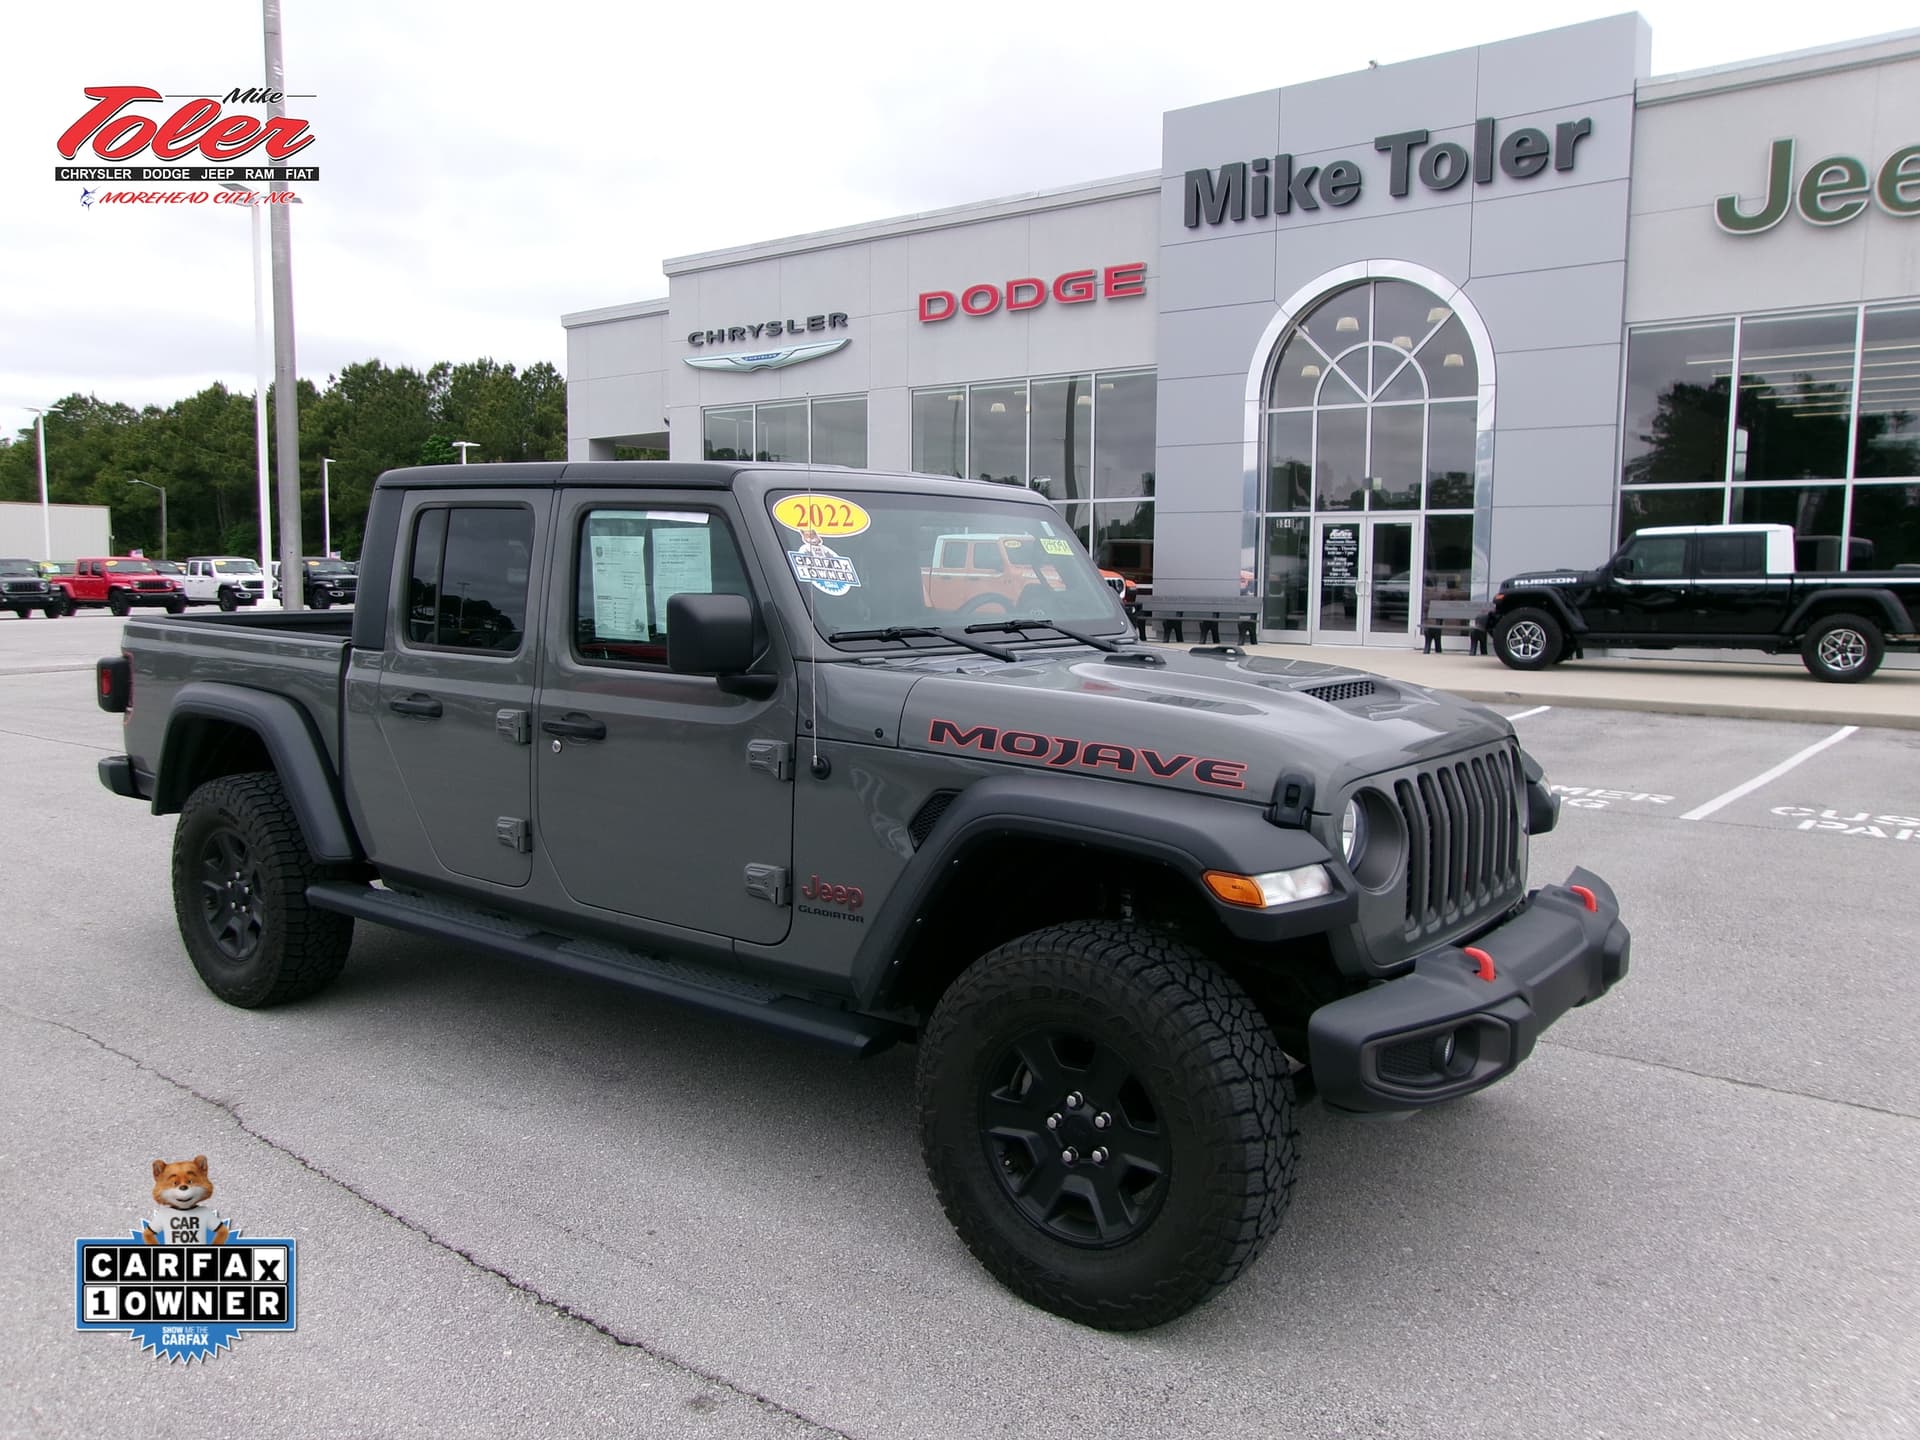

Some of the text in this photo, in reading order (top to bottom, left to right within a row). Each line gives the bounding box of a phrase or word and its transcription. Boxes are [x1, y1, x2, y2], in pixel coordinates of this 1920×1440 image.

[1183, 116, 1592, 228] Mike Toler
[1713, 135, 1920, 235] Jee
[918, 261, 1147, 323] DODGE
[687, 310, 849, 348] CHRYSLER
[793, 503, 855, 528] 2022
[795, 556, 852, 572] CARFAX
[809, 568, 855, 582] OWNER
[1514, 577, 1577, 586] RUBICON
[927, 717, 1248, 790] MOJAVE
[801, 873, 865, 913] Jeep
[798, 904, 865, 924] GLADIATOR
